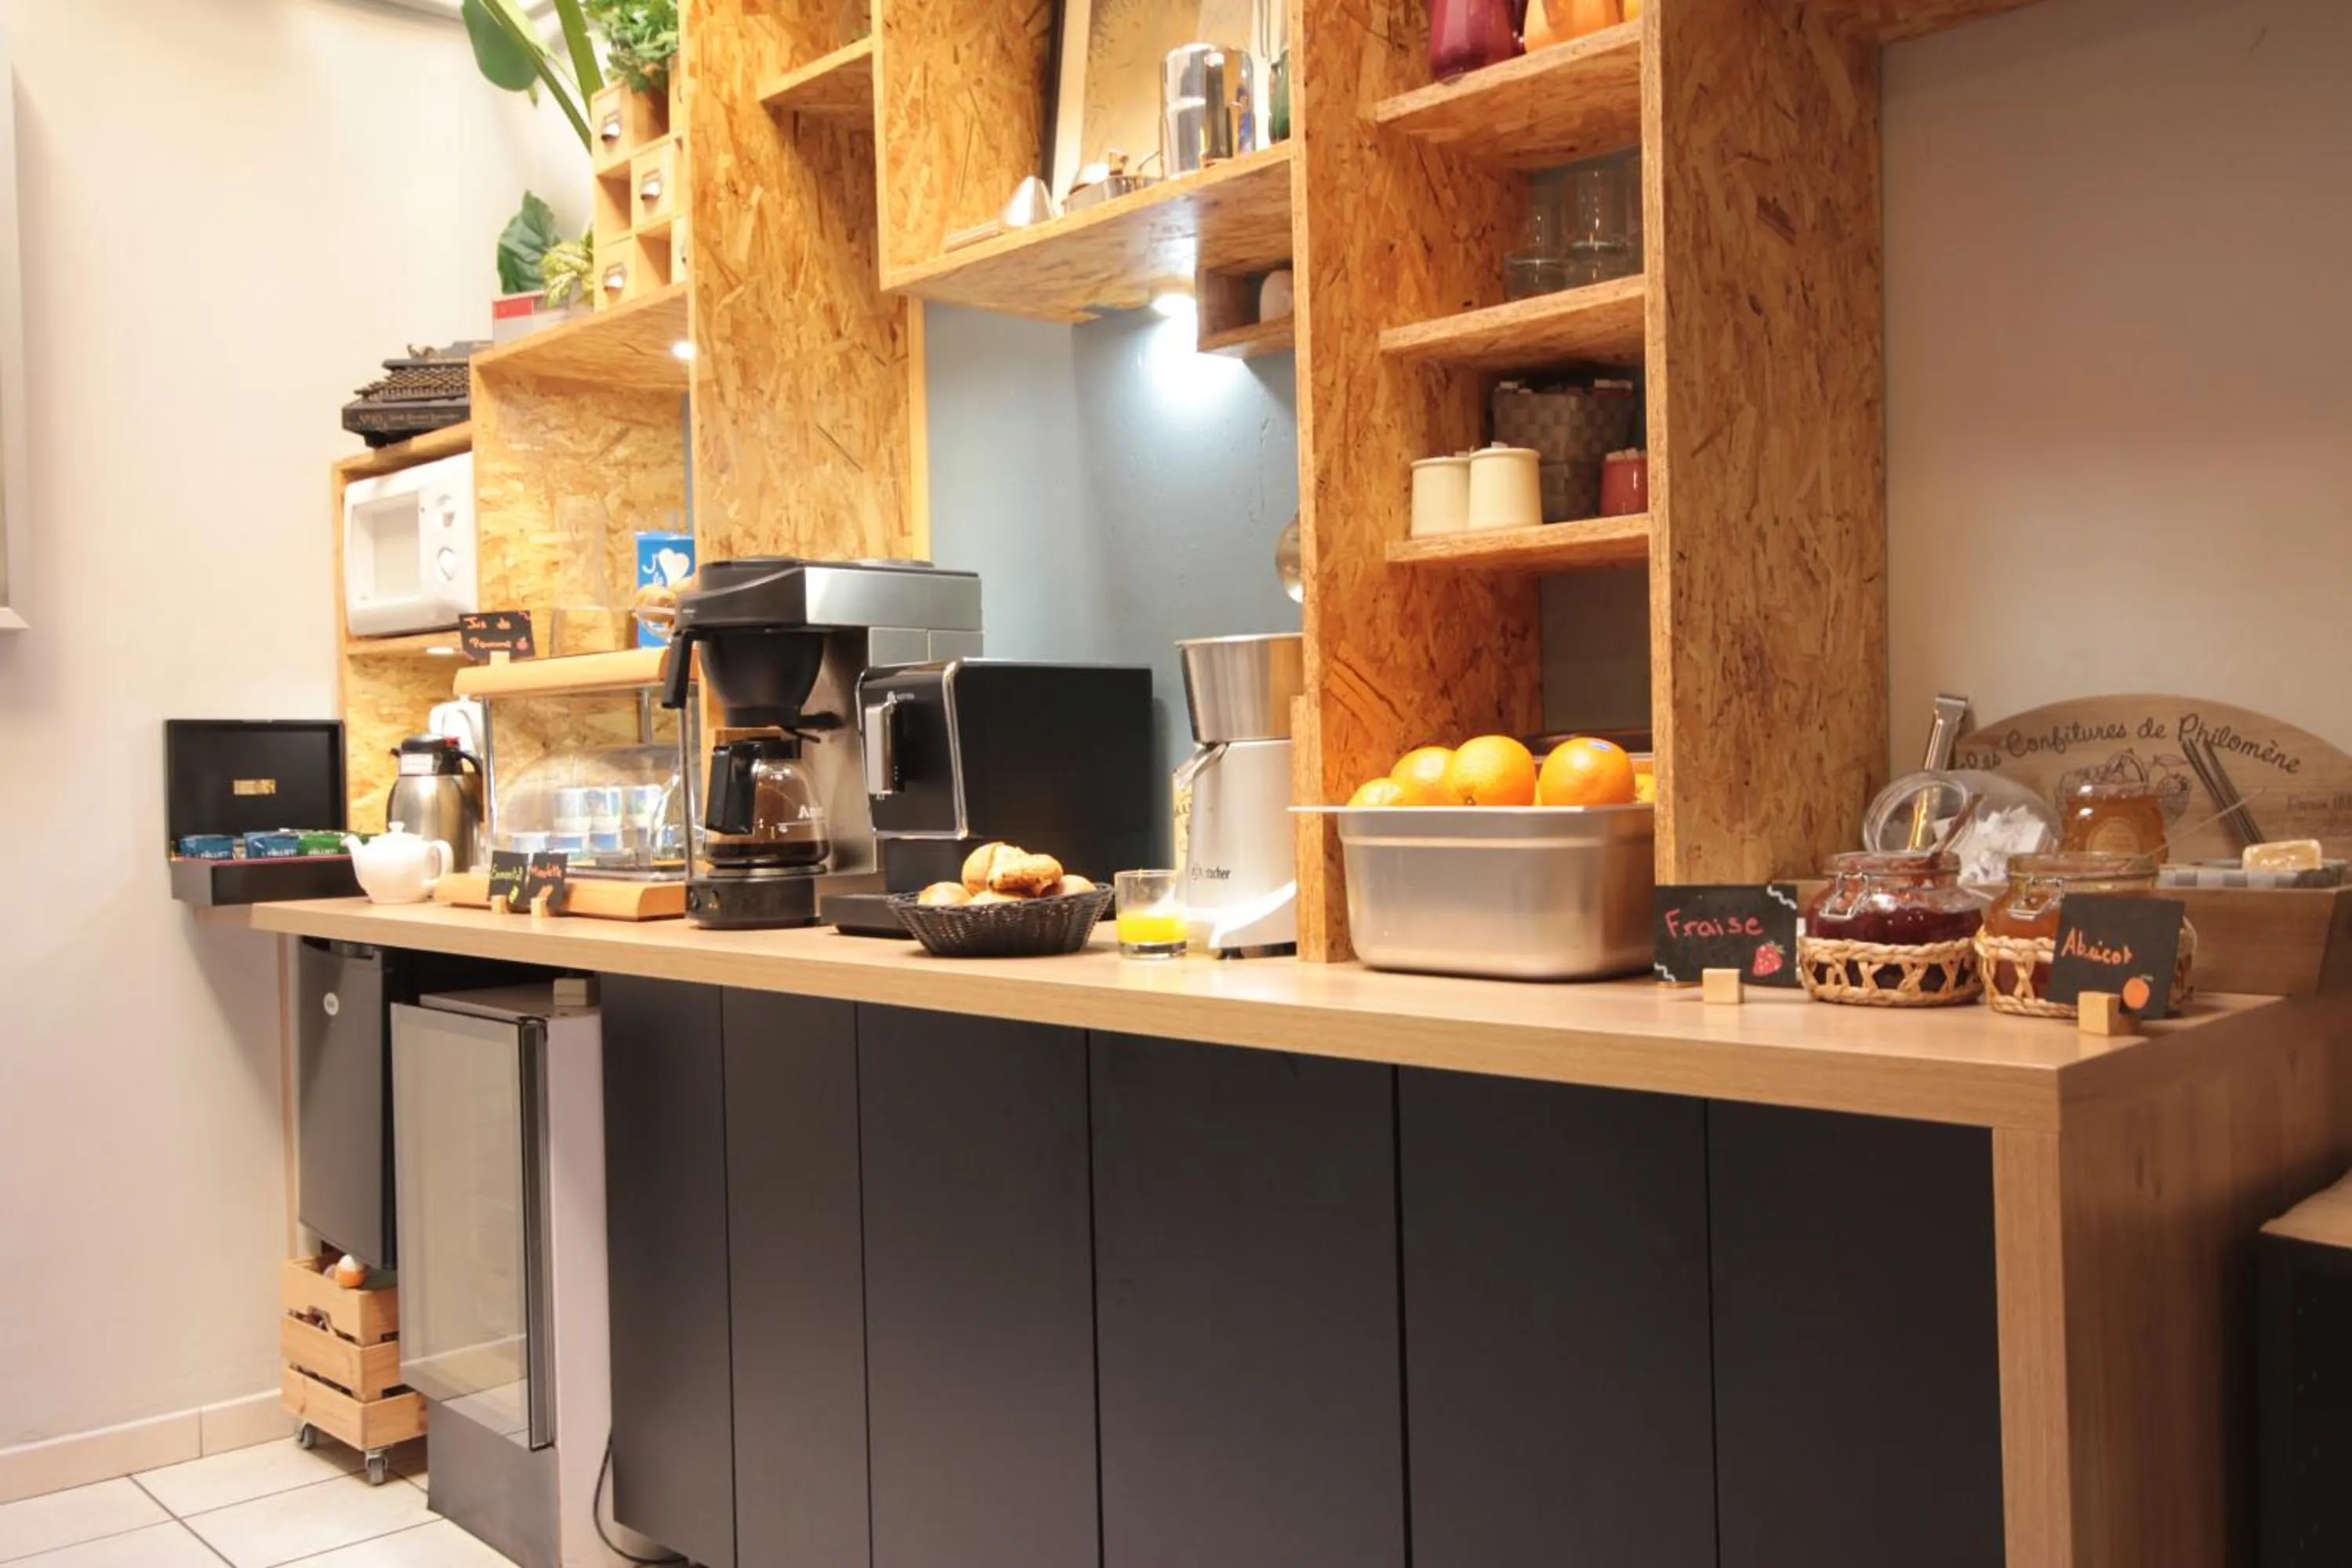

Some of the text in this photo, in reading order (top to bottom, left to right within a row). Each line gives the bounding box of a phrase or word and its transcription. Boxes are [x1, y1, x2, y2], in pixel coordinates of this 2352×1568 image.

[2006, 720, 2127, 758] Confitures
[2137, 716, 2167, 739] de
[2178, 713, 2301, 774] Philomène
[1664, 909, 1763, 938] Fraise
